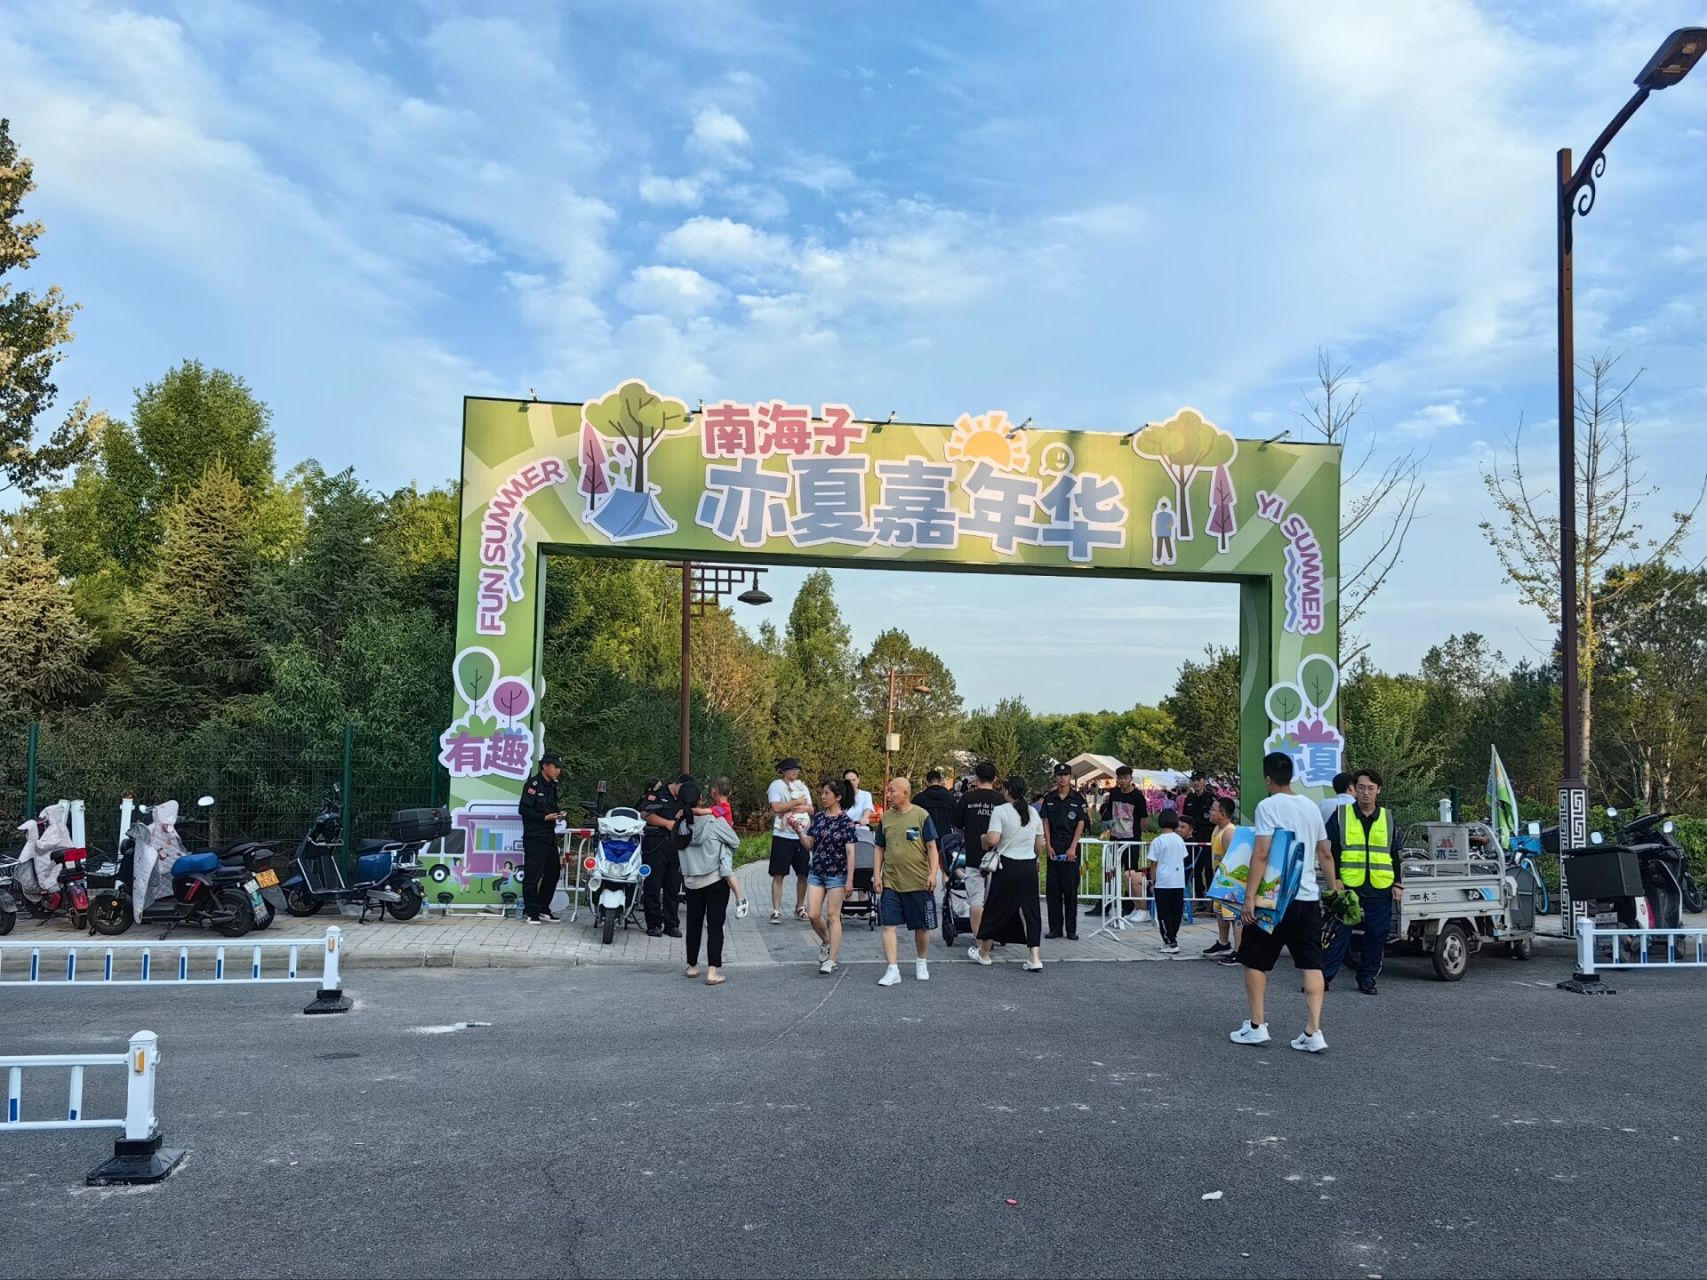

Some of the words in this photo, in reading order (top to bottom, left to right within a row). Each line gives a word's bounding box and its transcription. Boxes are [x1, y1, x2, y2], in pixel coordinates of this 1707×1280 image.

[705, 403, 865, 456] 南海子
[484, 460, 564, 562] SUMMER
[699, 457, 1125, 559] 亦夏嘉年华
[480, 572, 504, 631] FUN
[1259, 494, 1284, 519] YI
[1284, 517, 1321, 632] SUMMER
[444, 732, 528, 775] 有趣
